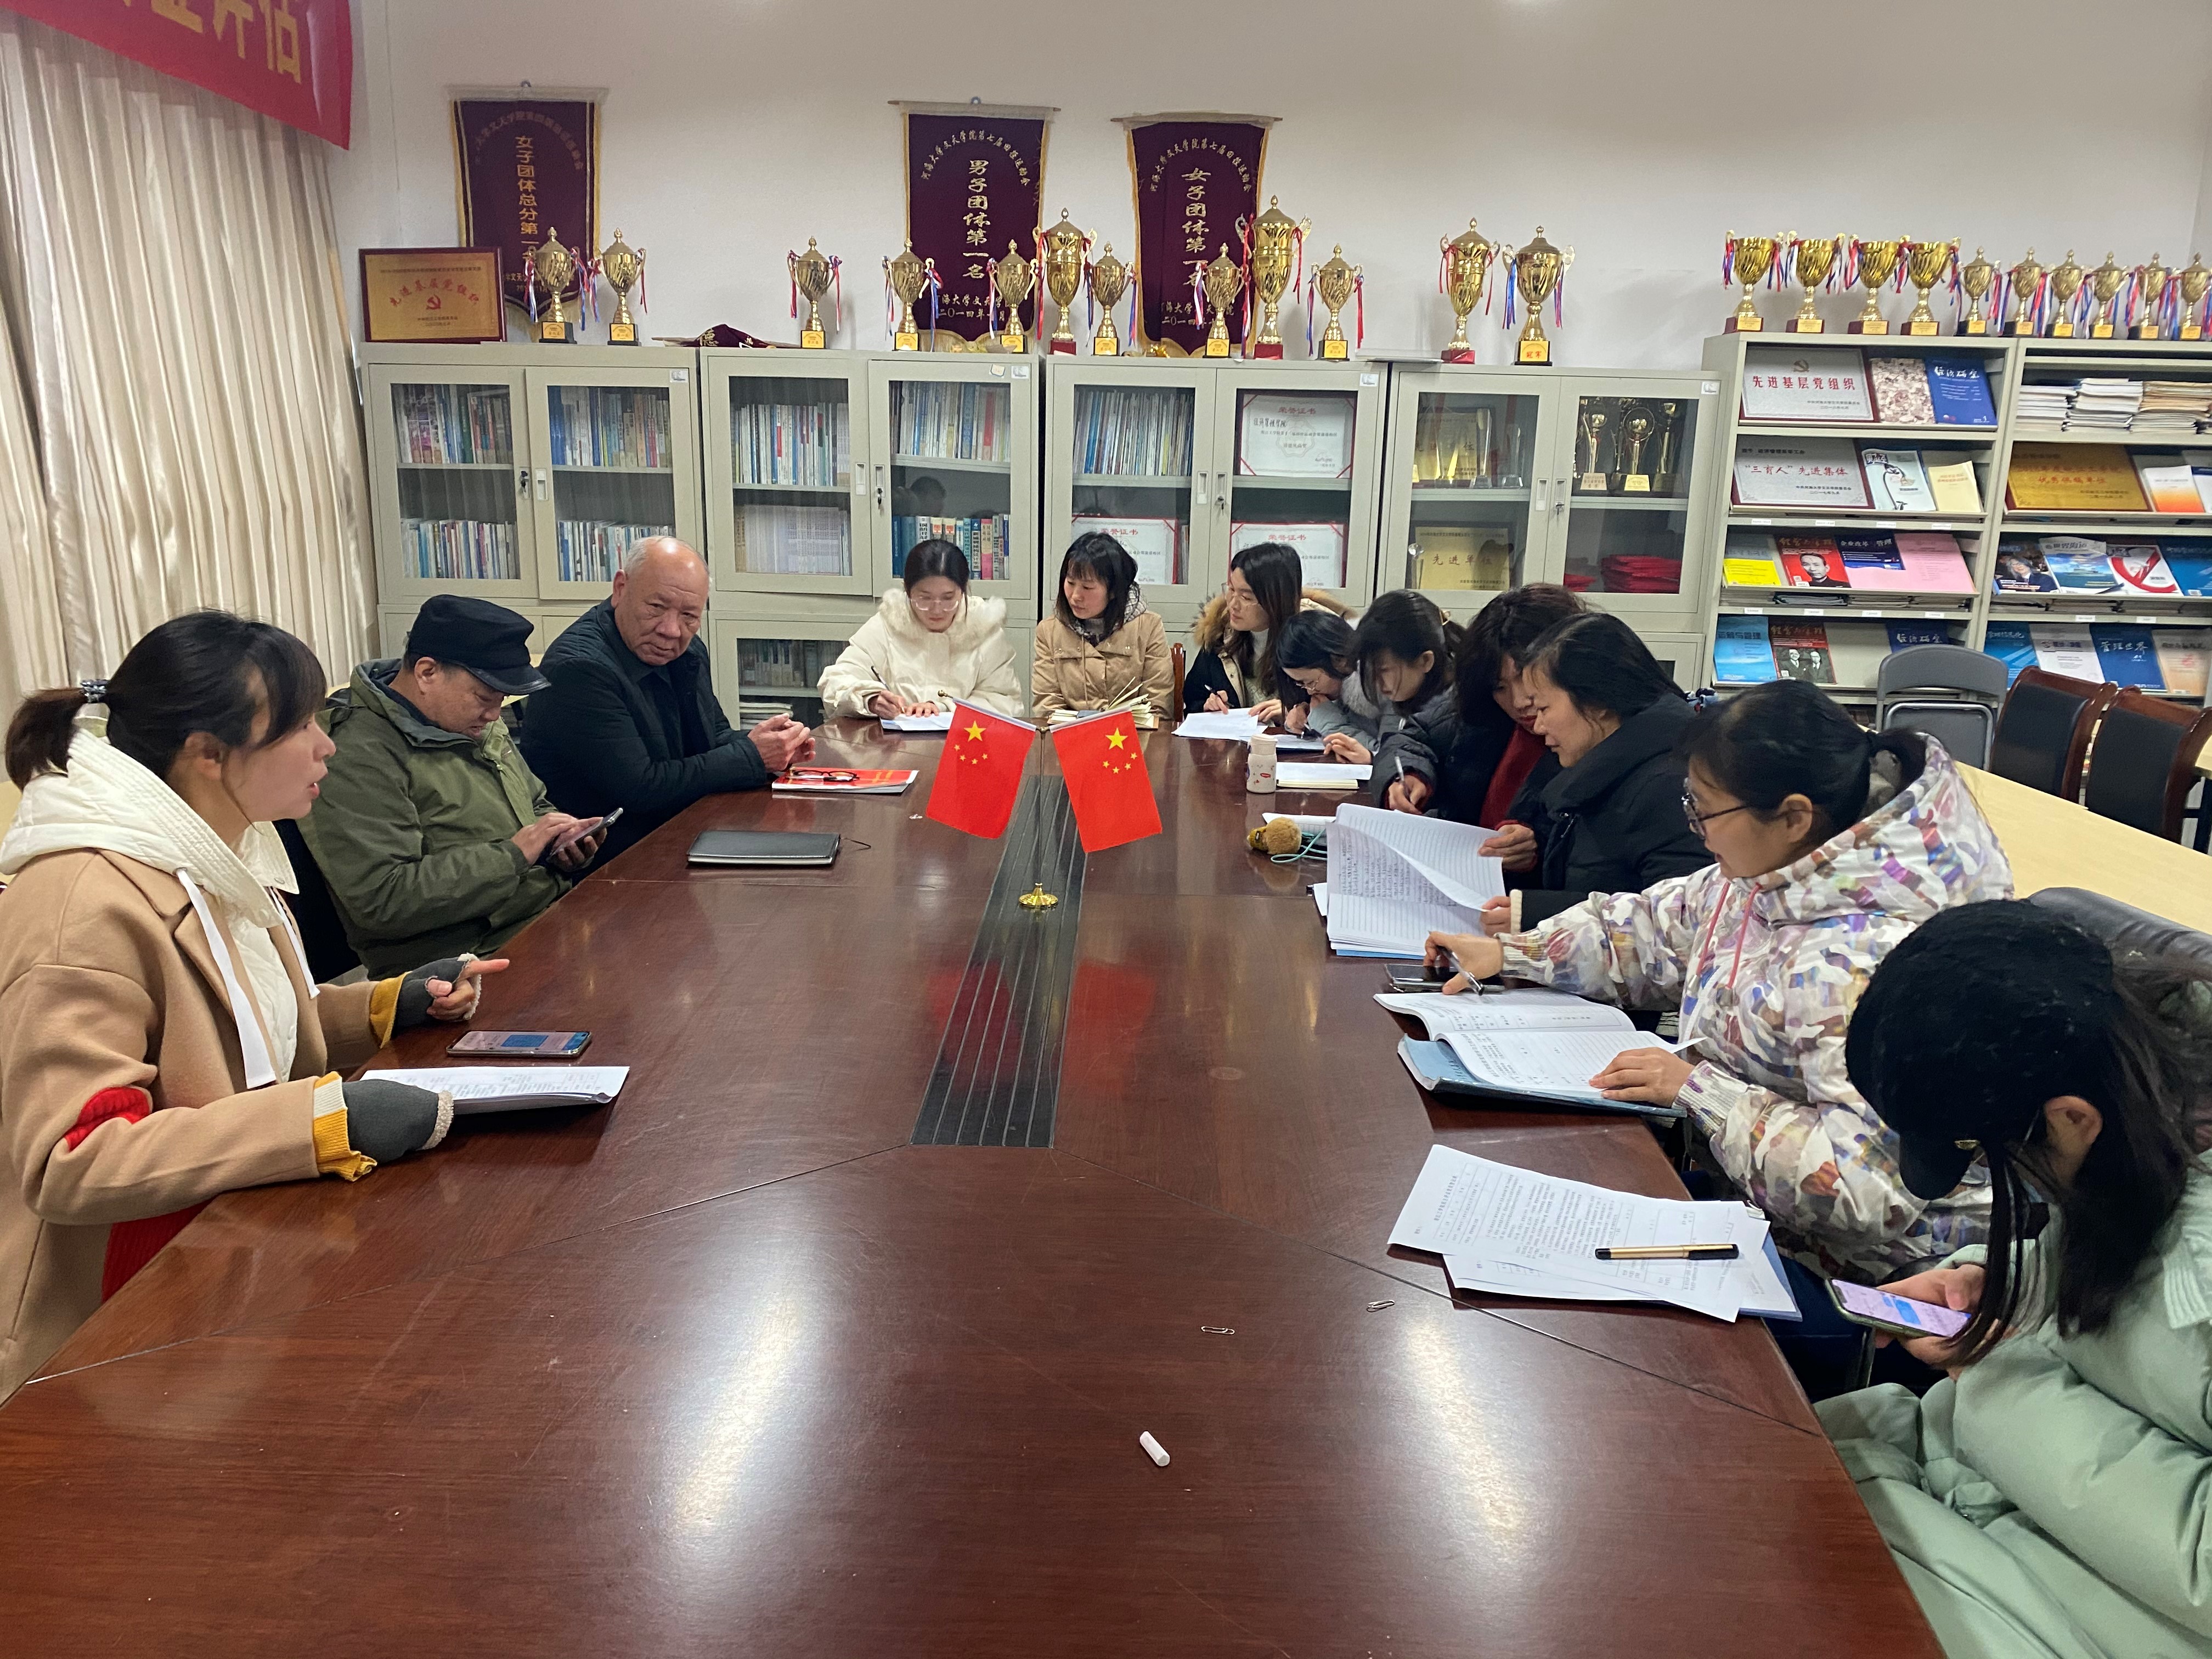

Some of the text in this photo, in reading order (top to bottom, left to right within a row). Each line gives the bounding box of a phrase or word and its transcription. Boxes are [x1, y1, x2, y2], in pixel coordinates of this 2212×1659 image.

[515, 136, 540, 261] 女子团体总分第一
[962, 160, 991, 279] 男子团体第一名
[1753, 376, 1856, 390] 先进基层党组织
[2100, 641, 2148, 655] 管理世界
